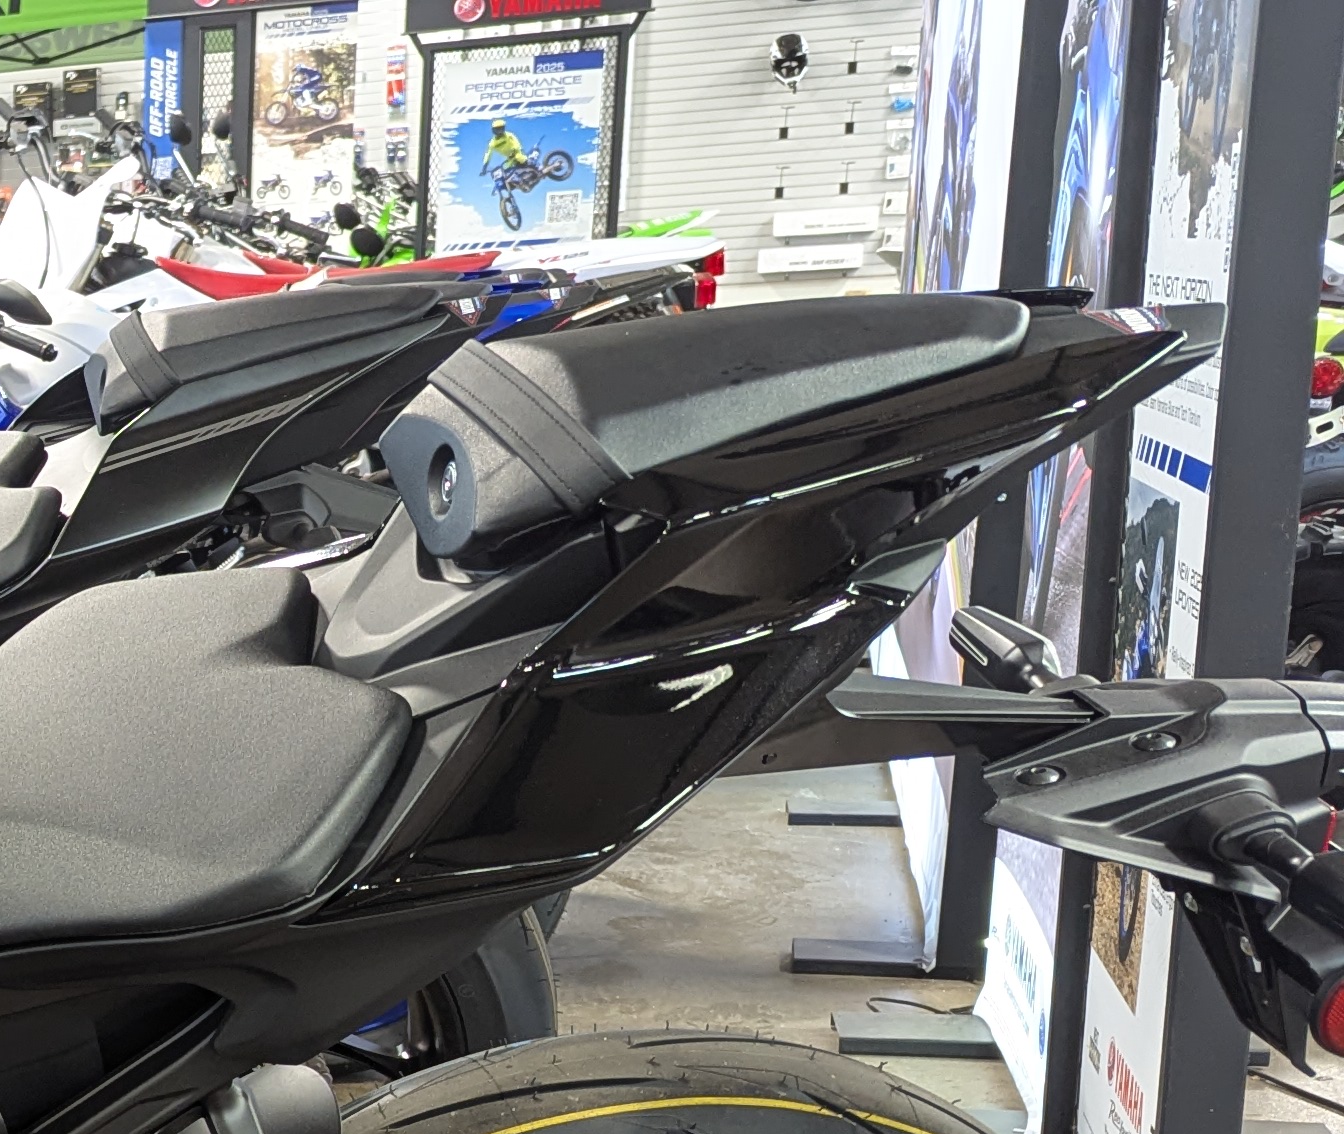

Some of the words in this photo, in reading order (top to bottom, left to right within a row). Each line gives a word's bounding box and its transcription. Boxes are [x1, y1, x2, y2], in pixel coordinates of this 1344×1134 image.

[264, 15, 348, 30] MOTOCROSS
[485, 65, 531, 77] YAMAHA
[536, 62, 565, 74] 2025
[465, 75, 582, 93] PERFORMANCE
[149, 56, 164, 137] OFF-ROAD
[480, 87, 566, 102] PRODUCTS
[1149, 273, 1161, 296] THE
[1162, 275, 1180, 298] NEXT
[1181, 277, 1213, 303] HORIZON
[1178, 560, 1190, 583] NEW
[1175, 587, 1200, 620] UPDATES
